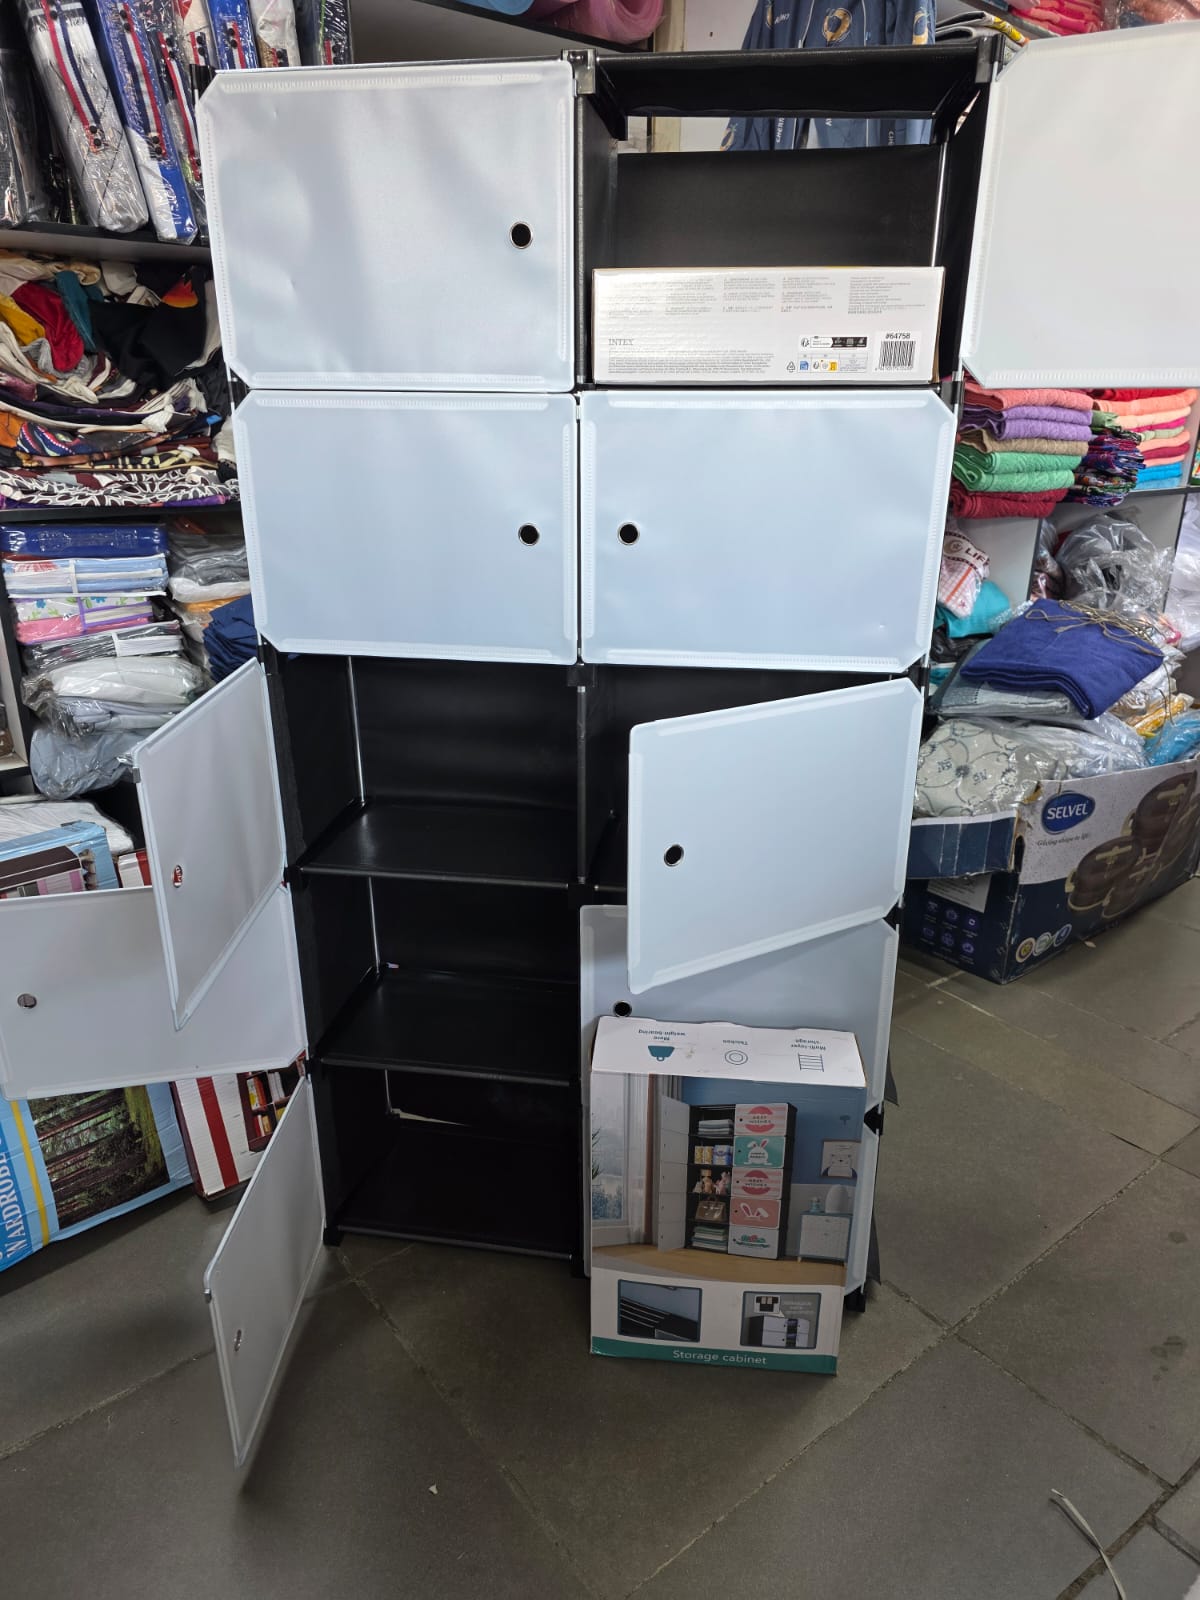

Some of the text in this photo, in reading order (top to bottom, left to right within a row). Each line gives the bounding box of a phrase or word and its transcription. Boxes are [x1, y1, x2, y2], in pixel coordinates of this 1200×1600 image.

[608, 338, 634, 346] INTEX
[1046, 803, 1088, 820] SELVEL
[672, 1349, 767, 1365] Storage cabinet
